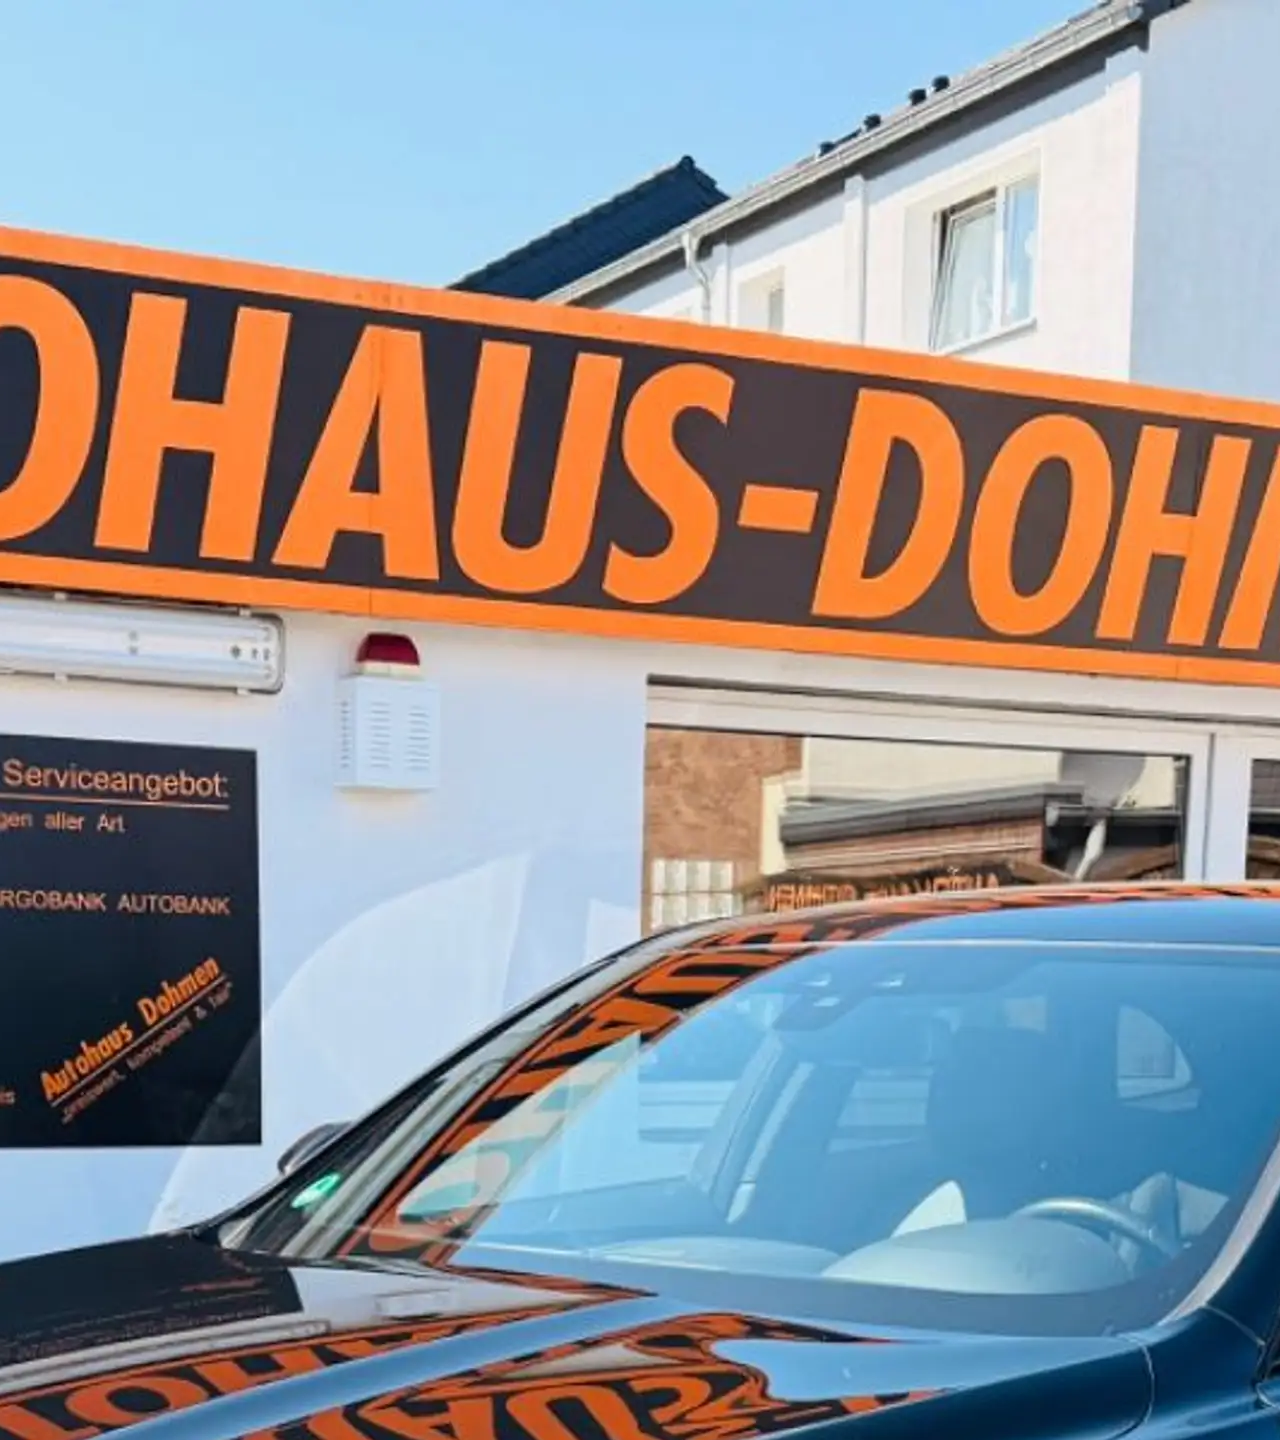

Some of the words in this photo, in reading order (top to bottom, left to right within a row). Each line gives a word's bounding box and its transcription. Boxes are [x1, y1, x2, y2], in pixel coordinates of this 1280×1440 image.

[2, 758, 230, 801] Serviceangebot:
[43, 811, 86, 832] aller
[116, 892, 232, 916] AUTOBANK
[40, 1020, 134, 1101] Autohaus
[136, 955, 221, 1027] Dohmen
